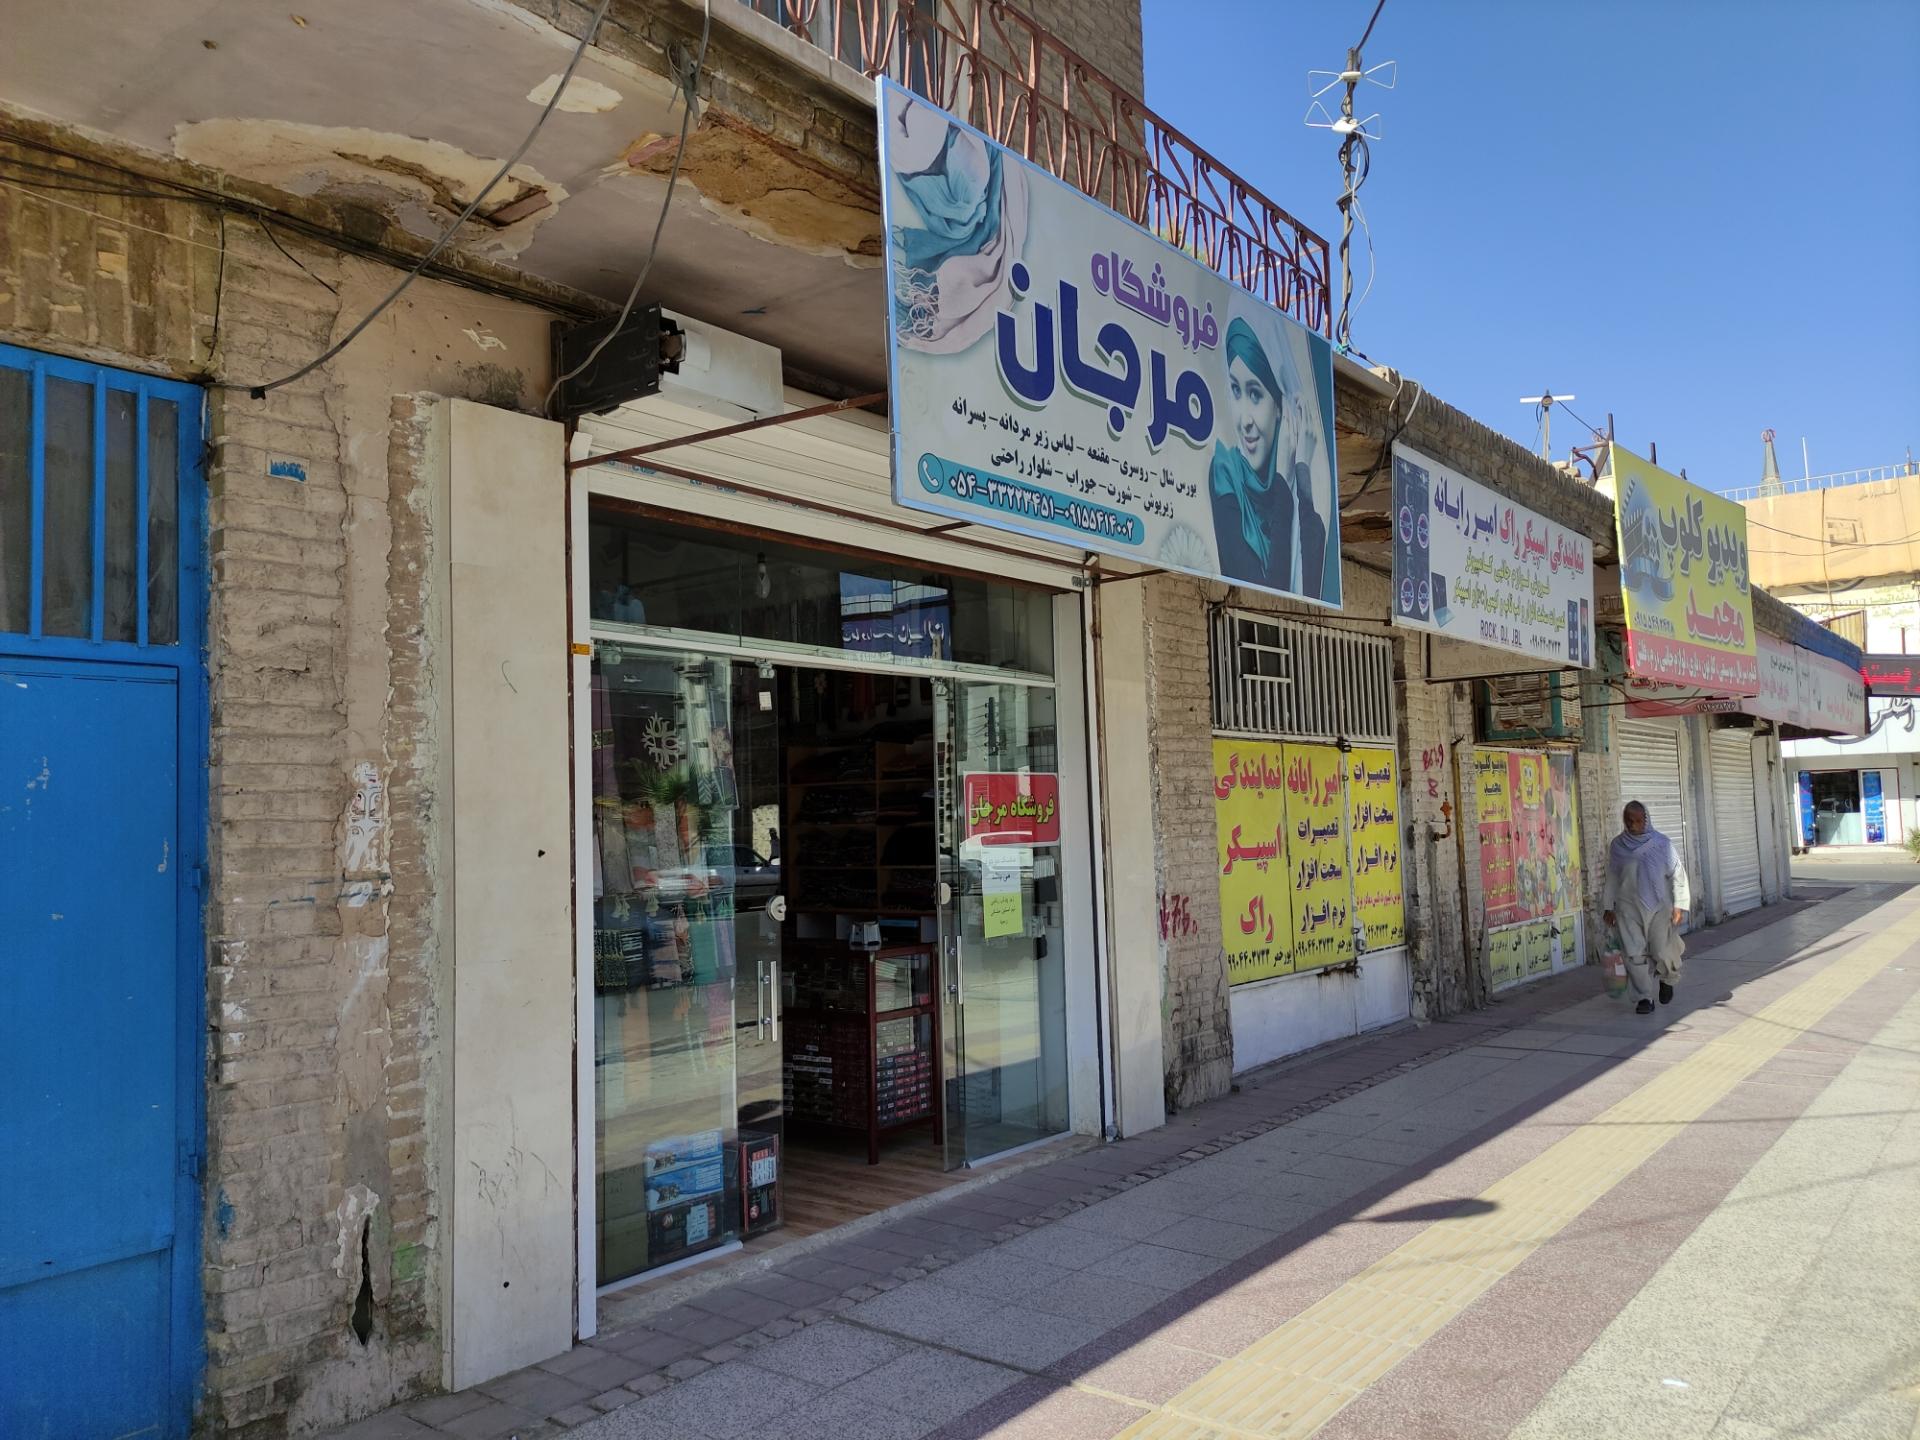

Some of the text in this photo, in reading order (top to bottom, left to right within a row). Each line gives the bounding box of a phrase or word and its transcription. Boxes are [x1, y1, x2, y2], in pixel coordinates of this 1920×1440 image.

[1090, 250, 1219, 353] فروشگاه
[995, 261, 1215, 454] مرجان
[952, 397, 1198, 499] بورس شال روسری مقنعه لباس زیر مردانه پسرانه
[991, 448, 1025, 474] راحتی
[1027, 454, 1053, 477] شلوار
[1066, 470, 1097, 495] جوراب
[1107, 483, 1133, 503] شورت
[1434, 476, 1470, 538] رایانه
[1472, 503, 1498, 543] امیر
[1658, 493, 1748, 594] ویدیو کلوپ
[1685, 587, 1746, 648] محمد
[1214, 753, 1282, 800] نمایندگی
[1287, 755, 1341, 806] امیر رایانه
[1353, 760, 1391, 789] تعمیرات
[969, 792, 1054, 826] فروشگاه مرجان
[1352, 800, 1394, 832] سخت افزار
[1298, 817, 1339, 846] تعمیرات
[1296, 857, 1343, 890] سخت افزار
[1356, 843, 1397, 875] نرم افزار
[1240, 895, 1275, 943] راک
[1301, 902, 1330, 935] افزار
[1332, 899, 1346, 928] نرم
